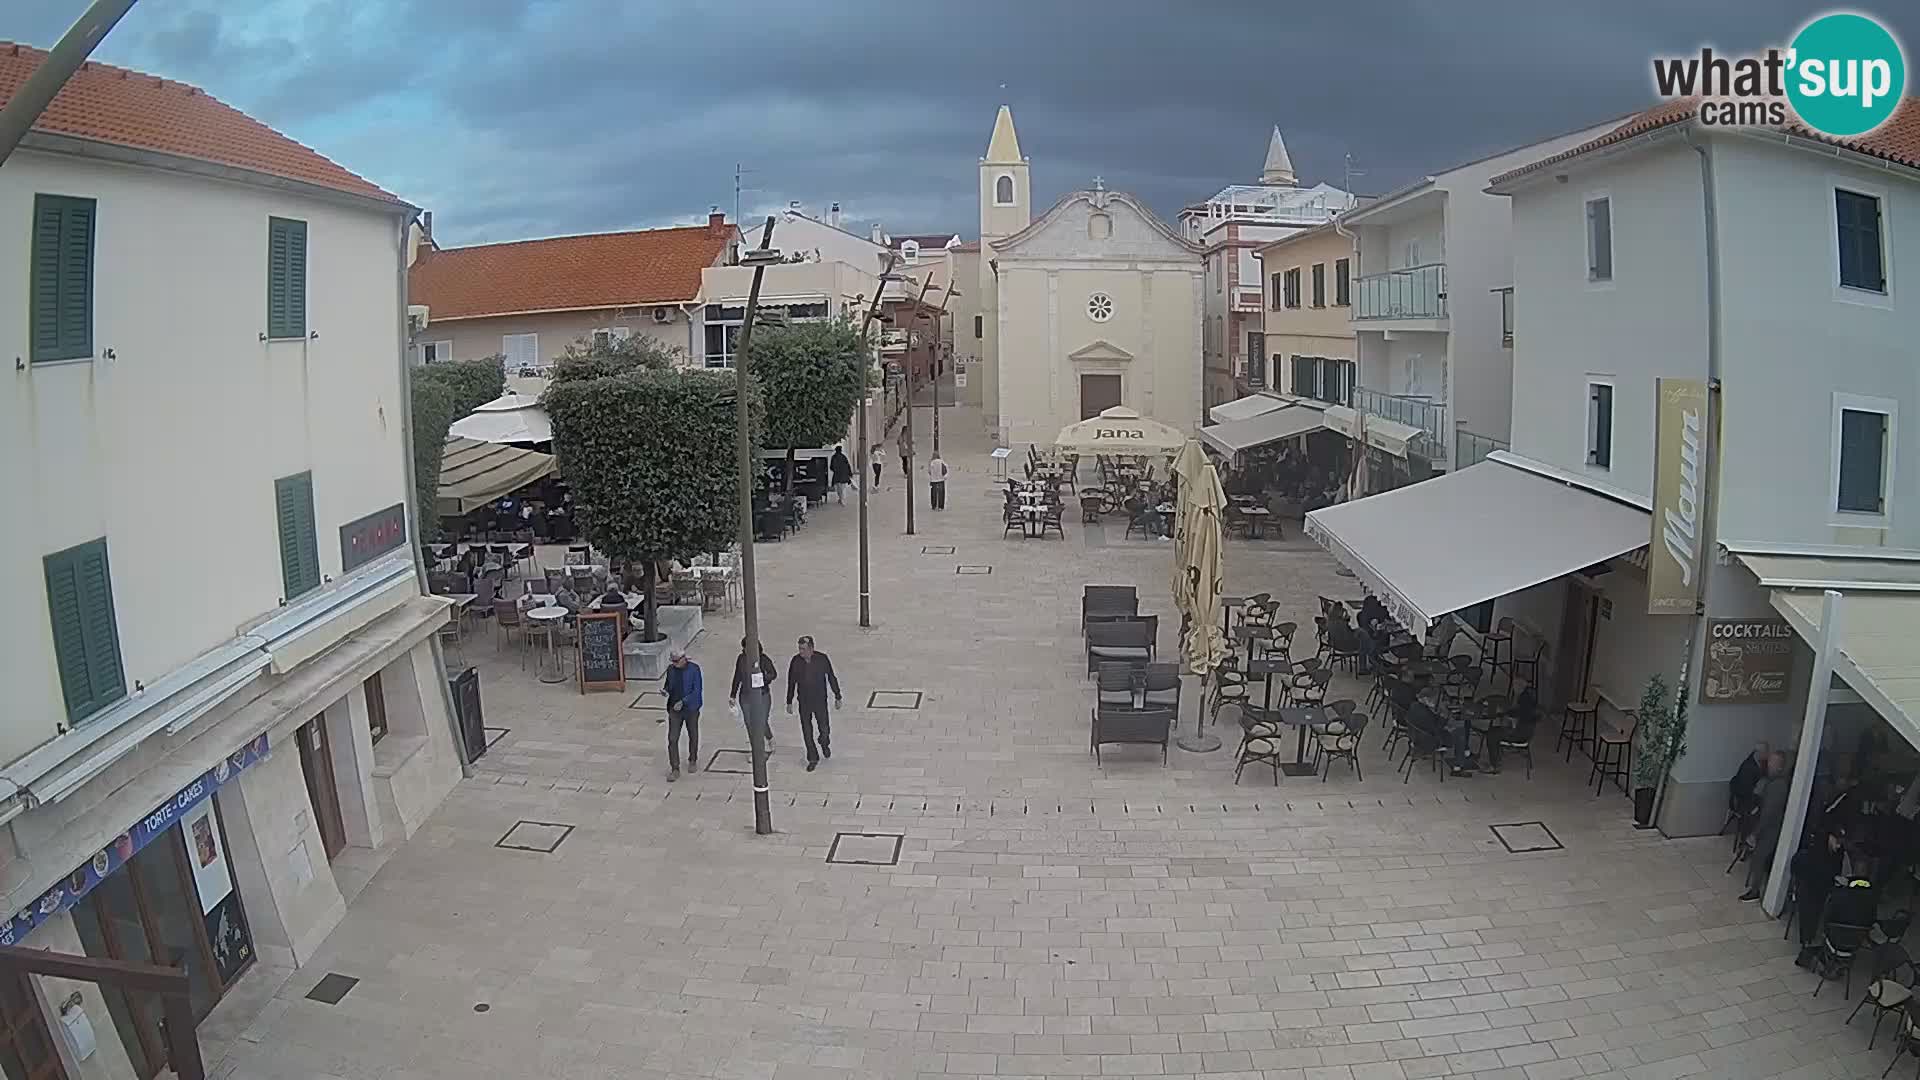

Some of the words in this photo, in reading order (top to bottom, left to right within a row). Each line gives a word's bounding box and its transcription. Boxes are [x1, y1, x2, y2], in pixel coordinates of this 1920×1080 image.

[1712, 623, 1792, 638] COCKTAILS
[144, 803, 173, 833] TORTE
[178, 780, 204, 808] CAKES
